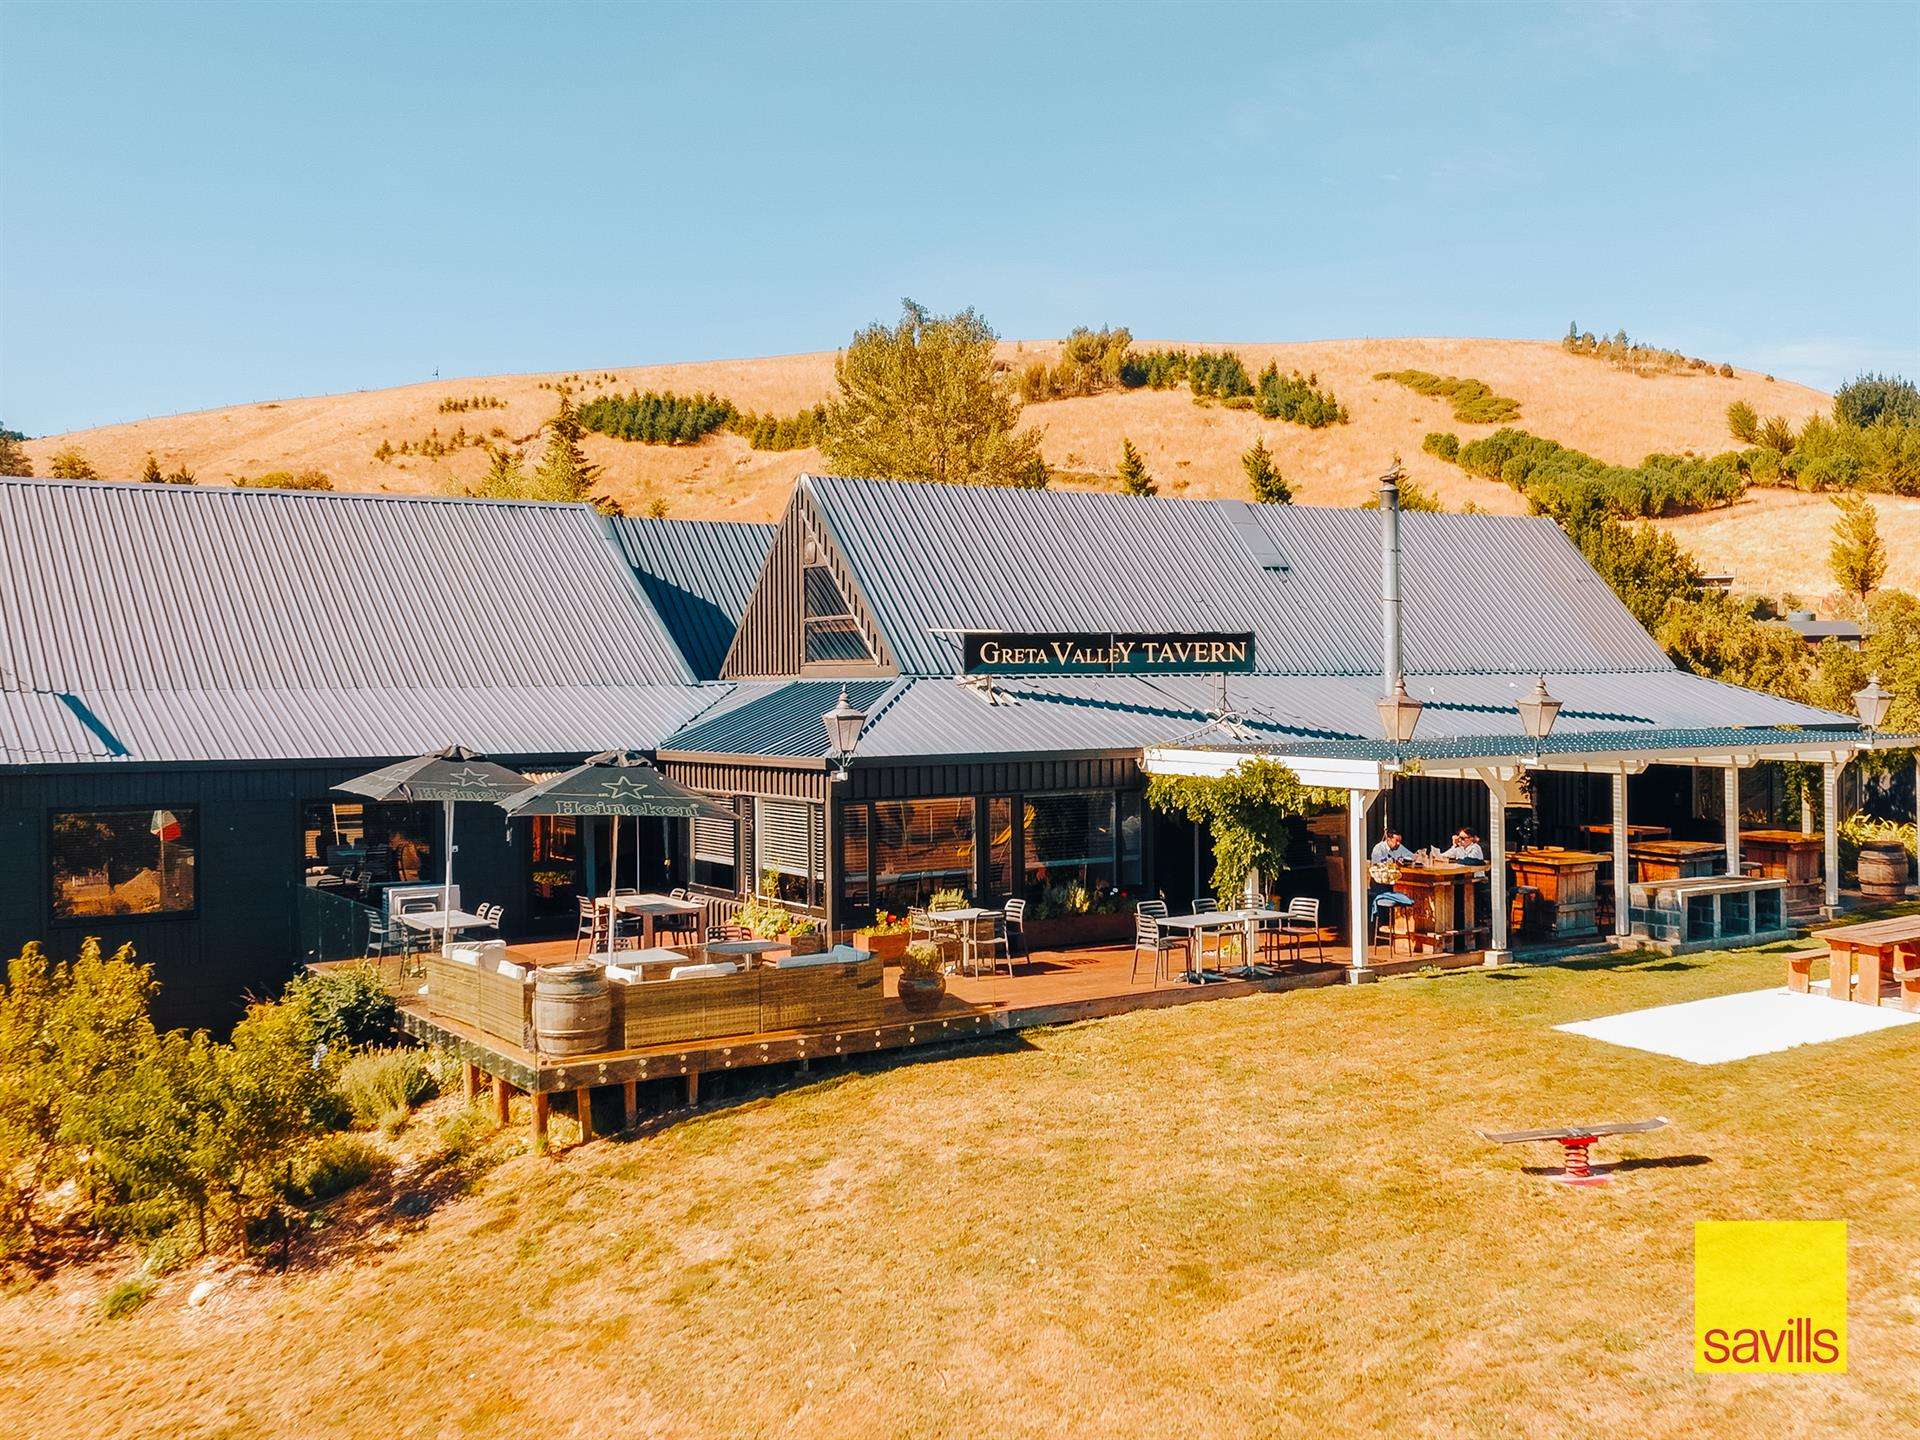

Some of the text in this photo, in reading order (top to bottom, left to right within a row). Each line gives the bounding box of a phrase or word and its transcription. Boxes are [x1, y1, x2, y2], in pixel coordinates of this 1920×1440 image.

[979, 641, 1247, 666] GRETA VALLEY TAVERN
[555, 800, 700, 817] Heineken
